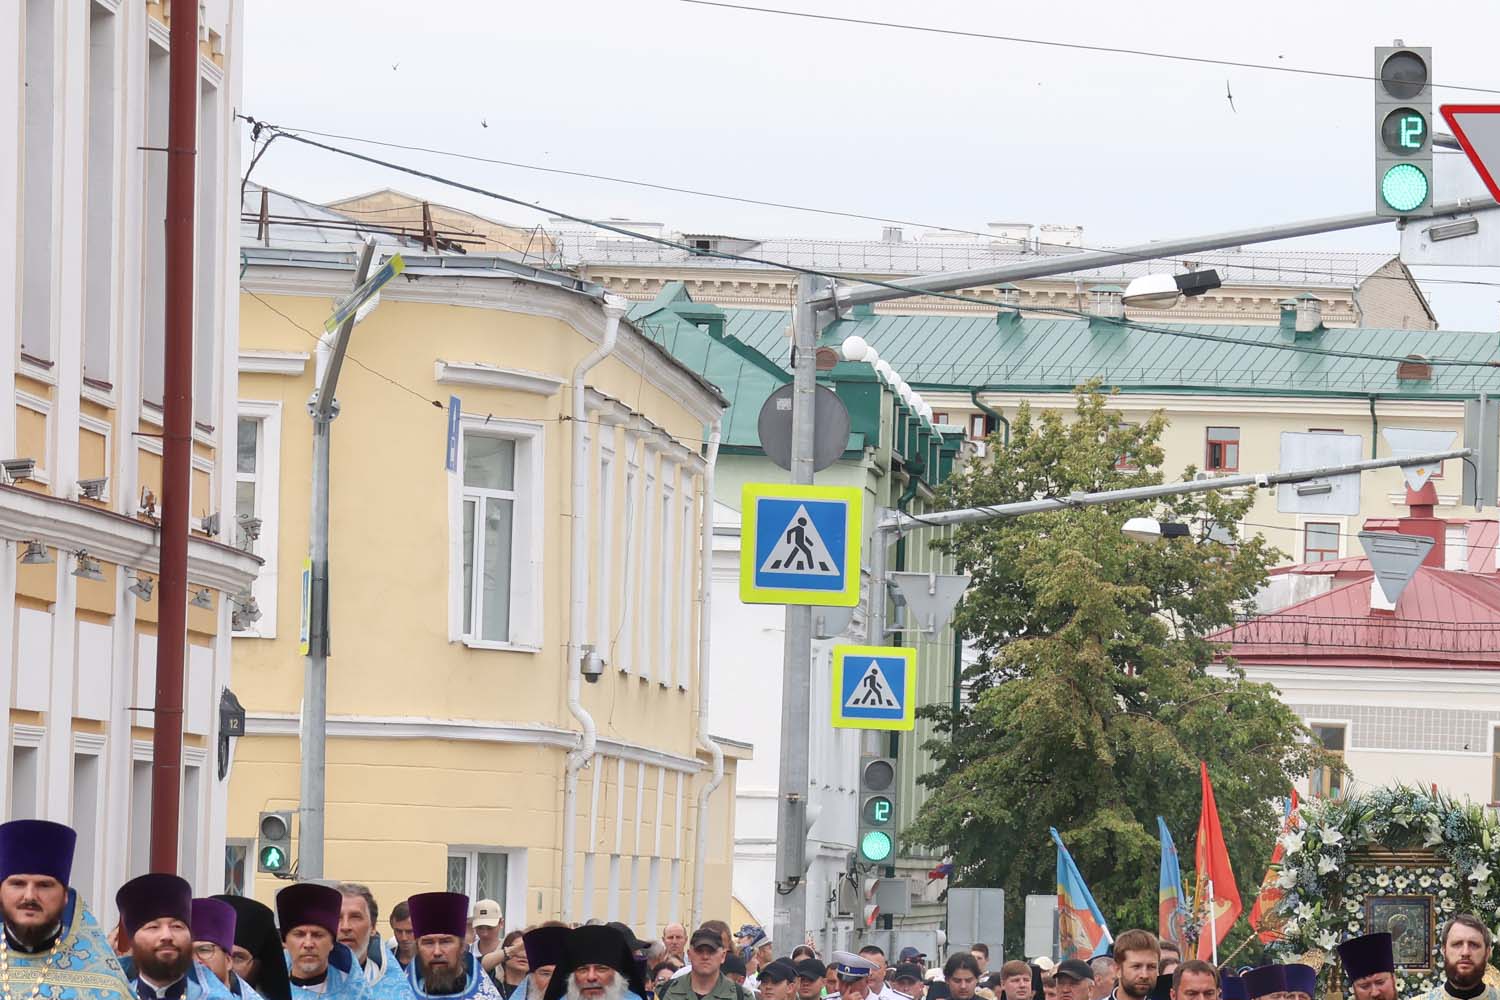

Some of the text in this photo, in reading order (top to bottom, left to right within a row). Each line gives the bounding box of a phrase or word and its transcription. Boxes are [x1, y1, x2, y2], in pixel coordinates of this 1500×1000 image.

[1401, 117, 1423, 148] 12
[230, 719, 239, 729] 12
[875, 802, 889, 821] 12
